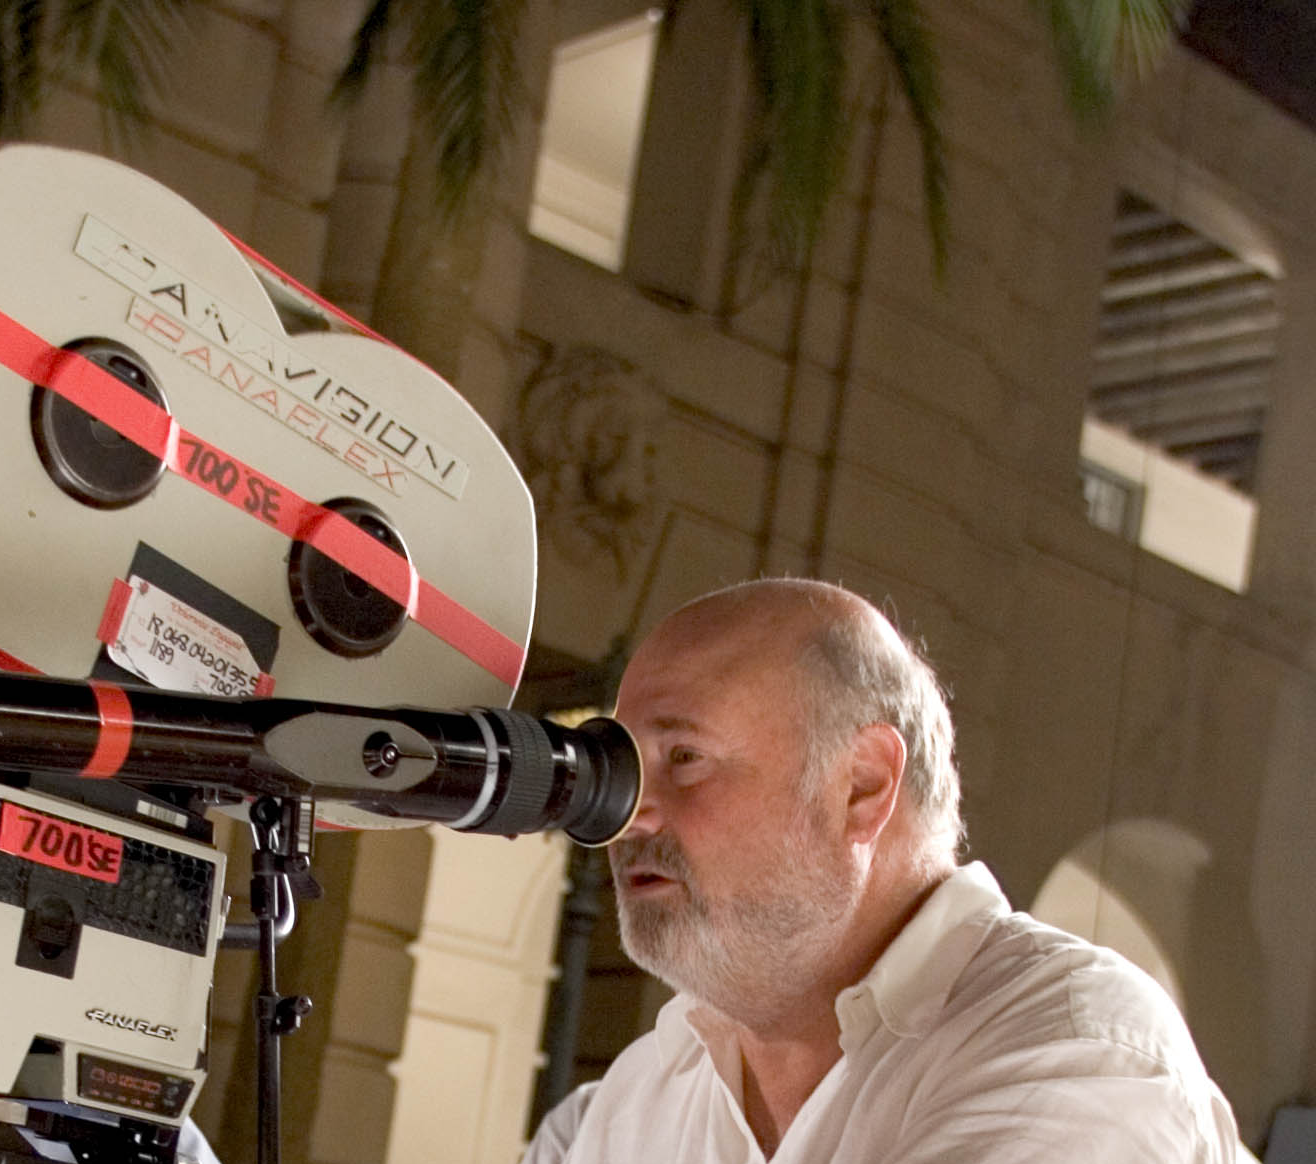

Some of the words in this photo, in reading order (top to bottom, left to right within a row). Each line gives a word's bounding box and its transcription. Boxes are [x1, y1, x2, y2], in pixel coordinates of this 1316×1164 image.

[91, 243, 455, 480] PANAVISION
[135, 312, 408, 488] PANAFLEX
[86, 1008, 179, 1041] PANAFLEX
